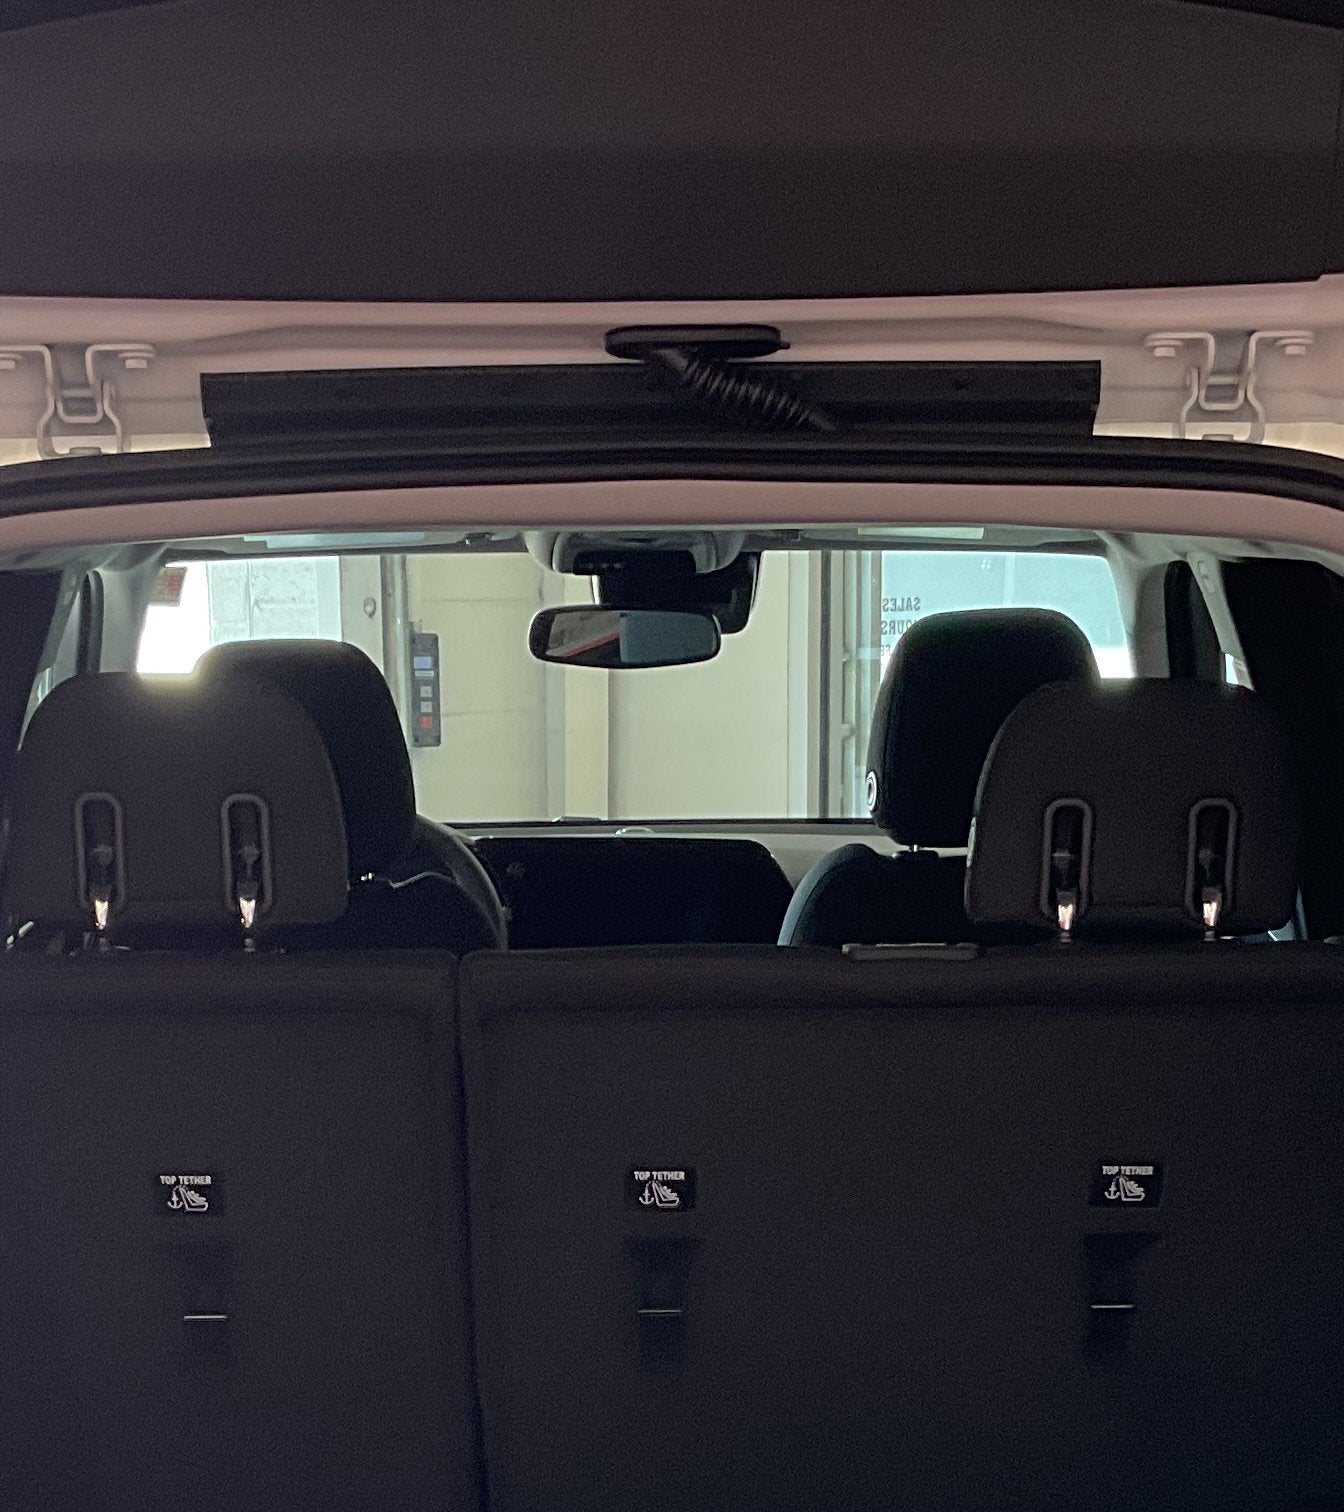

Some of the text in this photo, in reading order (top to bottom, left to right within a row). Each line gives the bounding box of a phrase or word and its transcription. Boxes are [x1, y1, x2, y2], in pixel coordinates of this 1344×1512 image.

[1102, 1165, 1154, 1175] TOP TETHER
[160, 1175, 212, 1185] TOP TETHER
[634, 1171, 685, 1181] TOP TETHER
